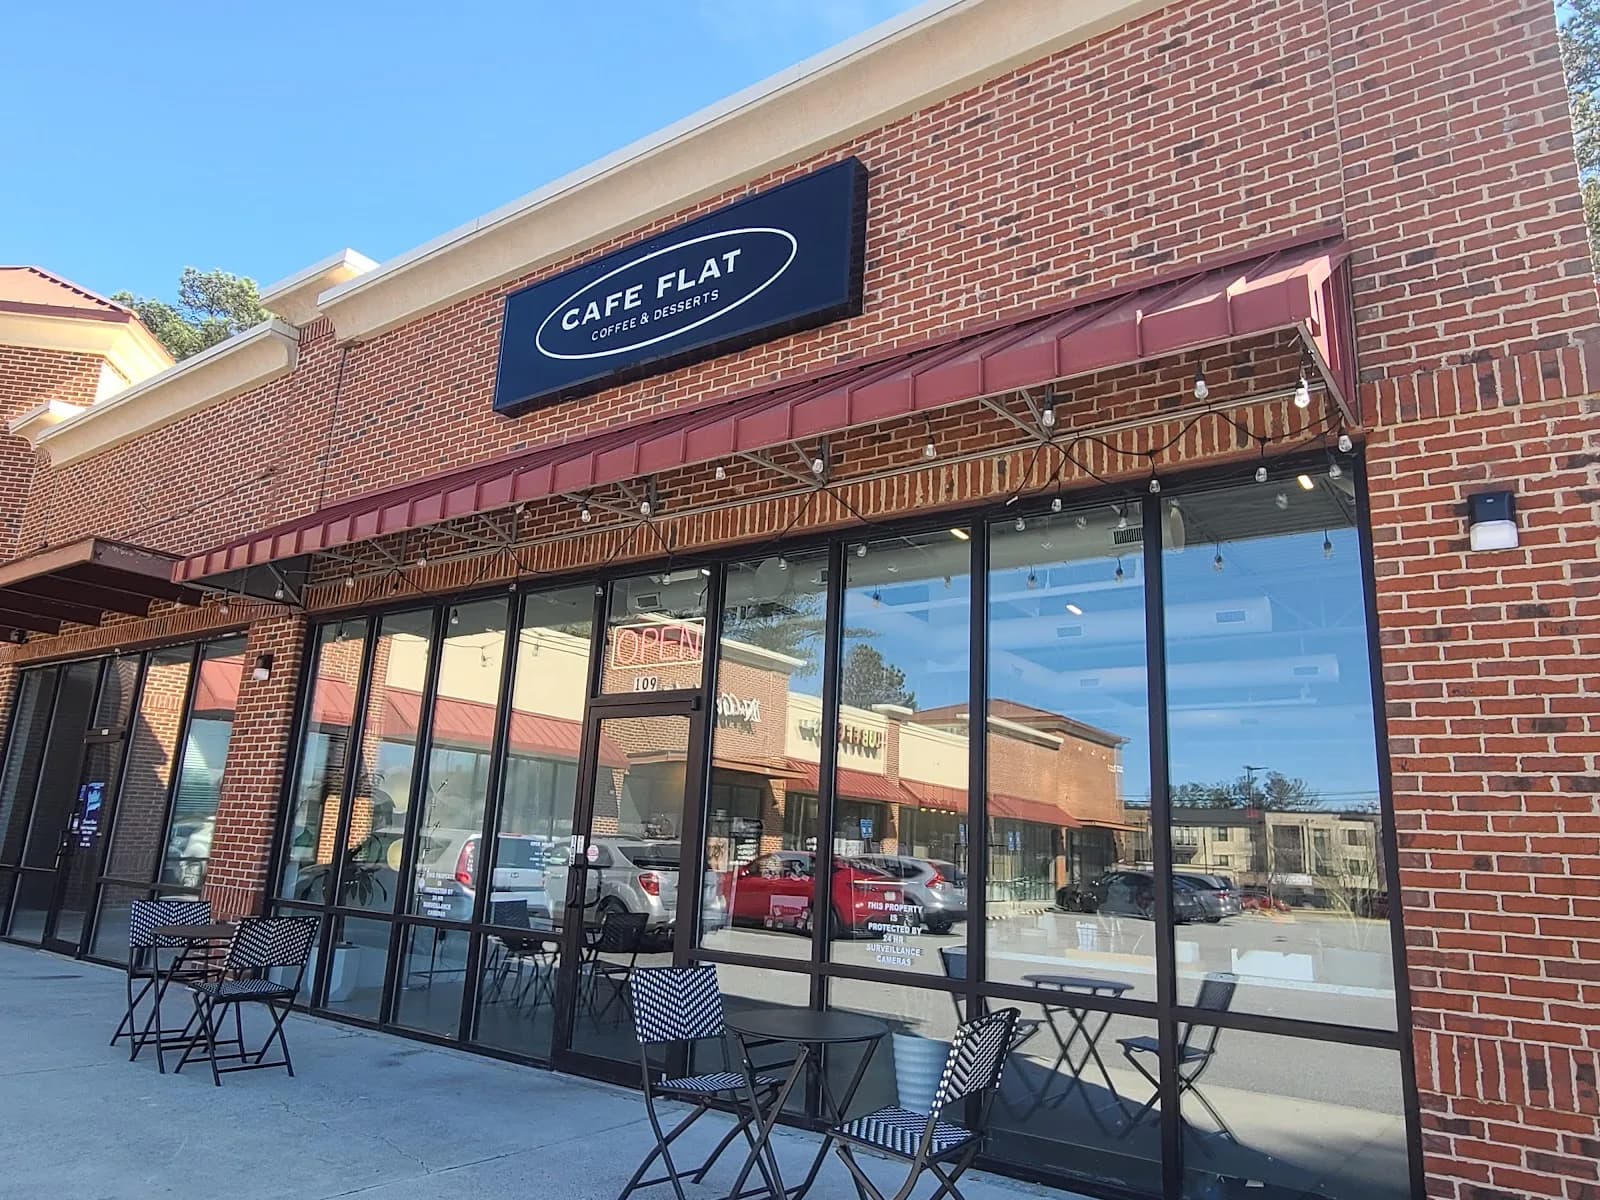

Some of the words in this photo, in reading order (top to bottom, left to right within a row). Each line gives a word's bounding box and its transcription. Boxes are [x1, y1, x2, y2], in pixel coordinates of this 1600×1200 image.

[561, 284, 644, 331] CAFE
[656, 248, 742, 298] FLAT
[591, 318, 637, 341] COFFEE
[639, 312, 650, 325] &
[653, 289, 720, 321] DESSERTS
[617, 624, 700, 664] OPEN
[635, 677, 657, 691] 109
[868, 902, 882, 910] THIS
[884, 904, 924, 914] PROPERTY
[890, 914, 898, 922] IS
[868, 922, 910, 934] PROTECTED
[911, 927, 922, 936] BY
[882, 934, 892, 942] 24
[866, 944, 921, 956] SURVEILLANCE
[876, 956, 912, 966] CAMERAS
